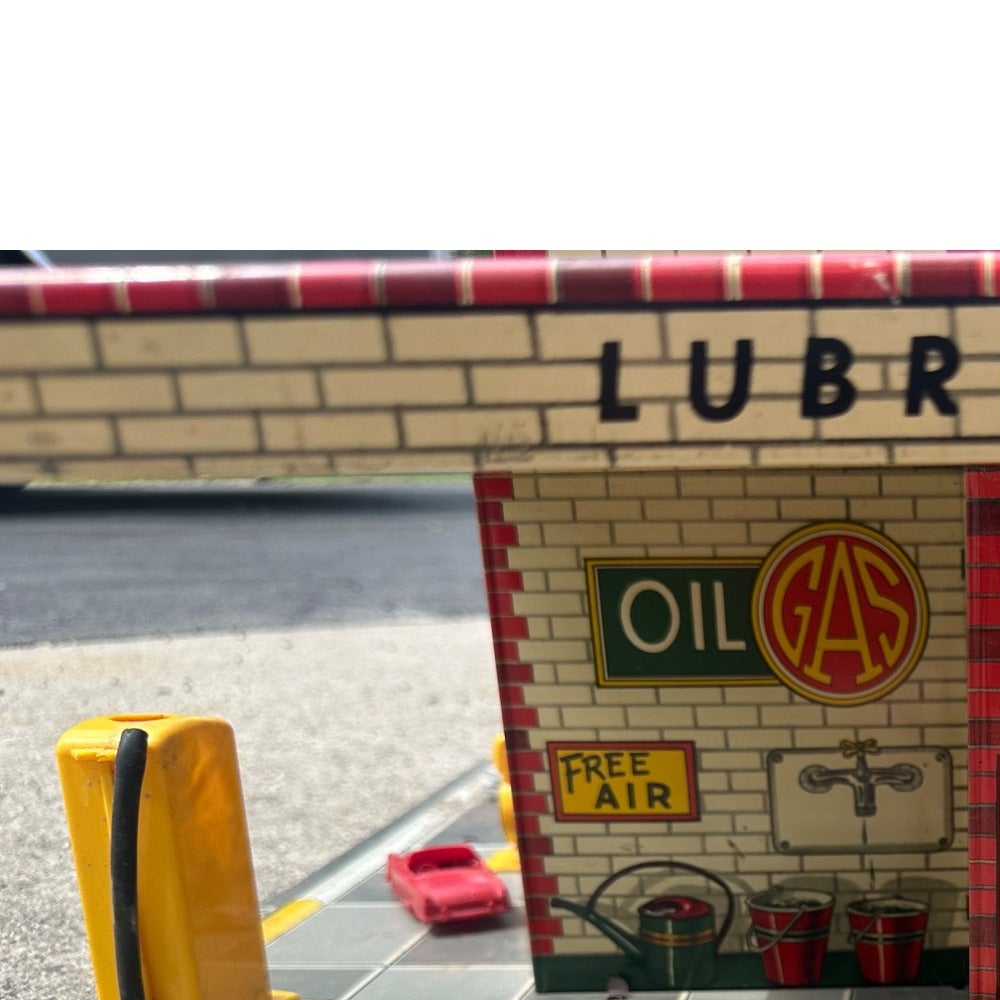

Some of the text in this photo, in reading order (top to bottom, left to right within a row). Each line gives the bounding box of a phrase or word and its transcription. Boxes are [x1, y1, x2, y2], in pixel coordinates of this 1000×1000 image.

[619, 579, 748, 653] OIL
[771, 541, 910, 685] GAS
[558, 751, 651, 795] FREE
[594, 781, 673, 810] AIR
